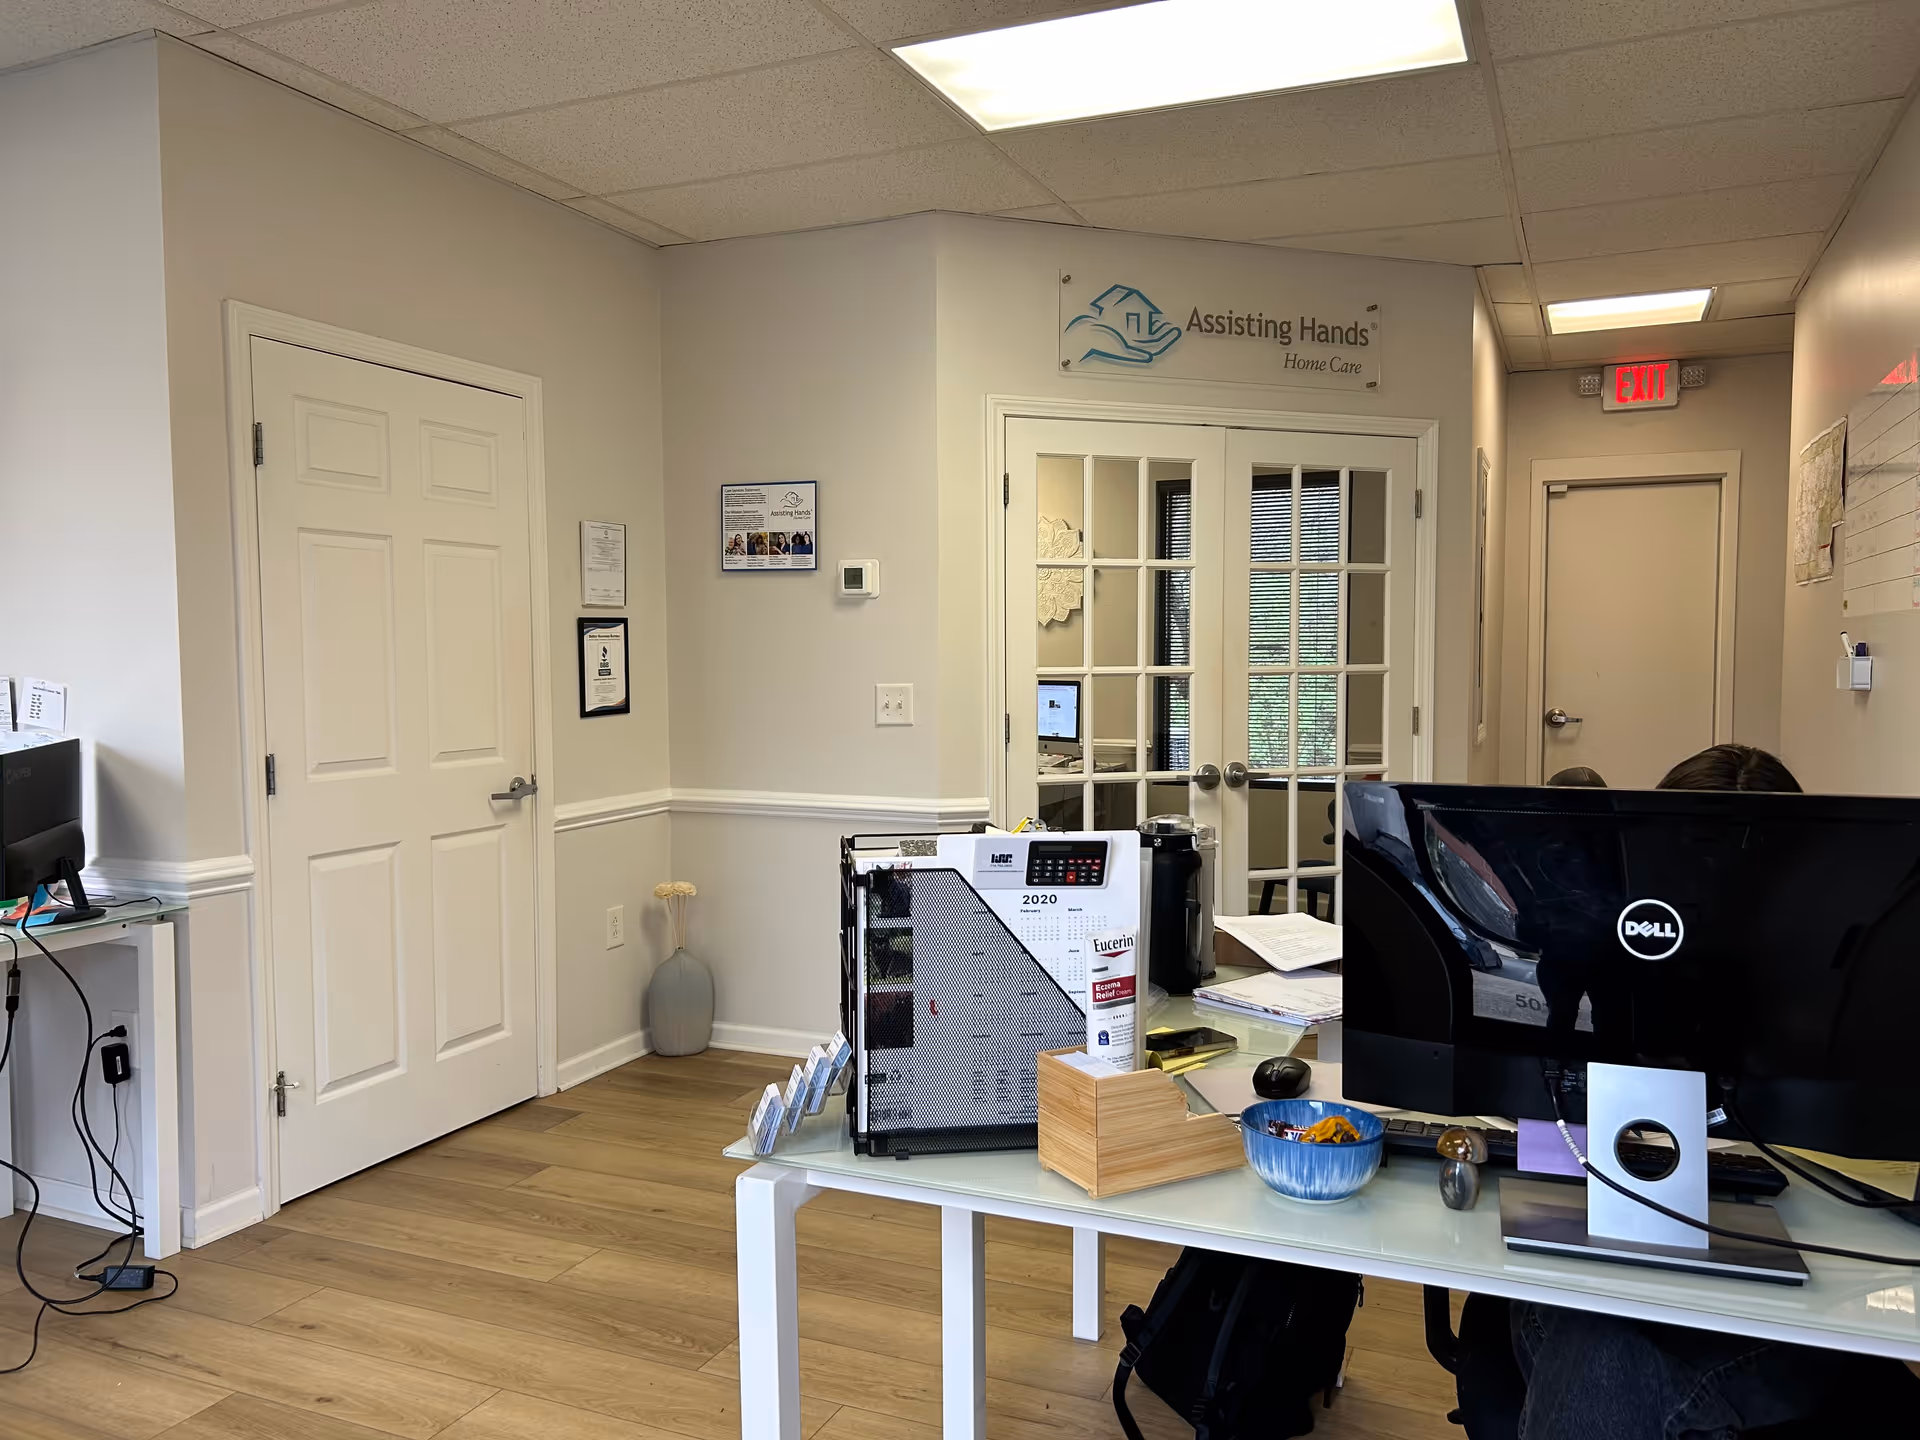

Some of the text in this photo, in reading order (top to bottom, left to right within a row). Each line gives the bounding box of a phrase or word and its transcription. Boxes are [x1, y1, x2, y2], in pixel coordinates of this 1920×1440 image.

[1186, 306, 1369, 347] Assisting Hands
[1283, 353, 1362, 374] Home Care
[1616, 363, 1669, 403] EXIT
[770, 509, 794, 517] Assisting
[1022, 894, 1057, 904] 2020
[1625, 920, 1676, 938] DELL
[1093, 934, 1134, 952] Eucerin
[1095, 981, 1121, 991] Eczema
[1095, 988, 1132, 1000] Relief Cream
[1516, 994, 1547, 1011] 50
